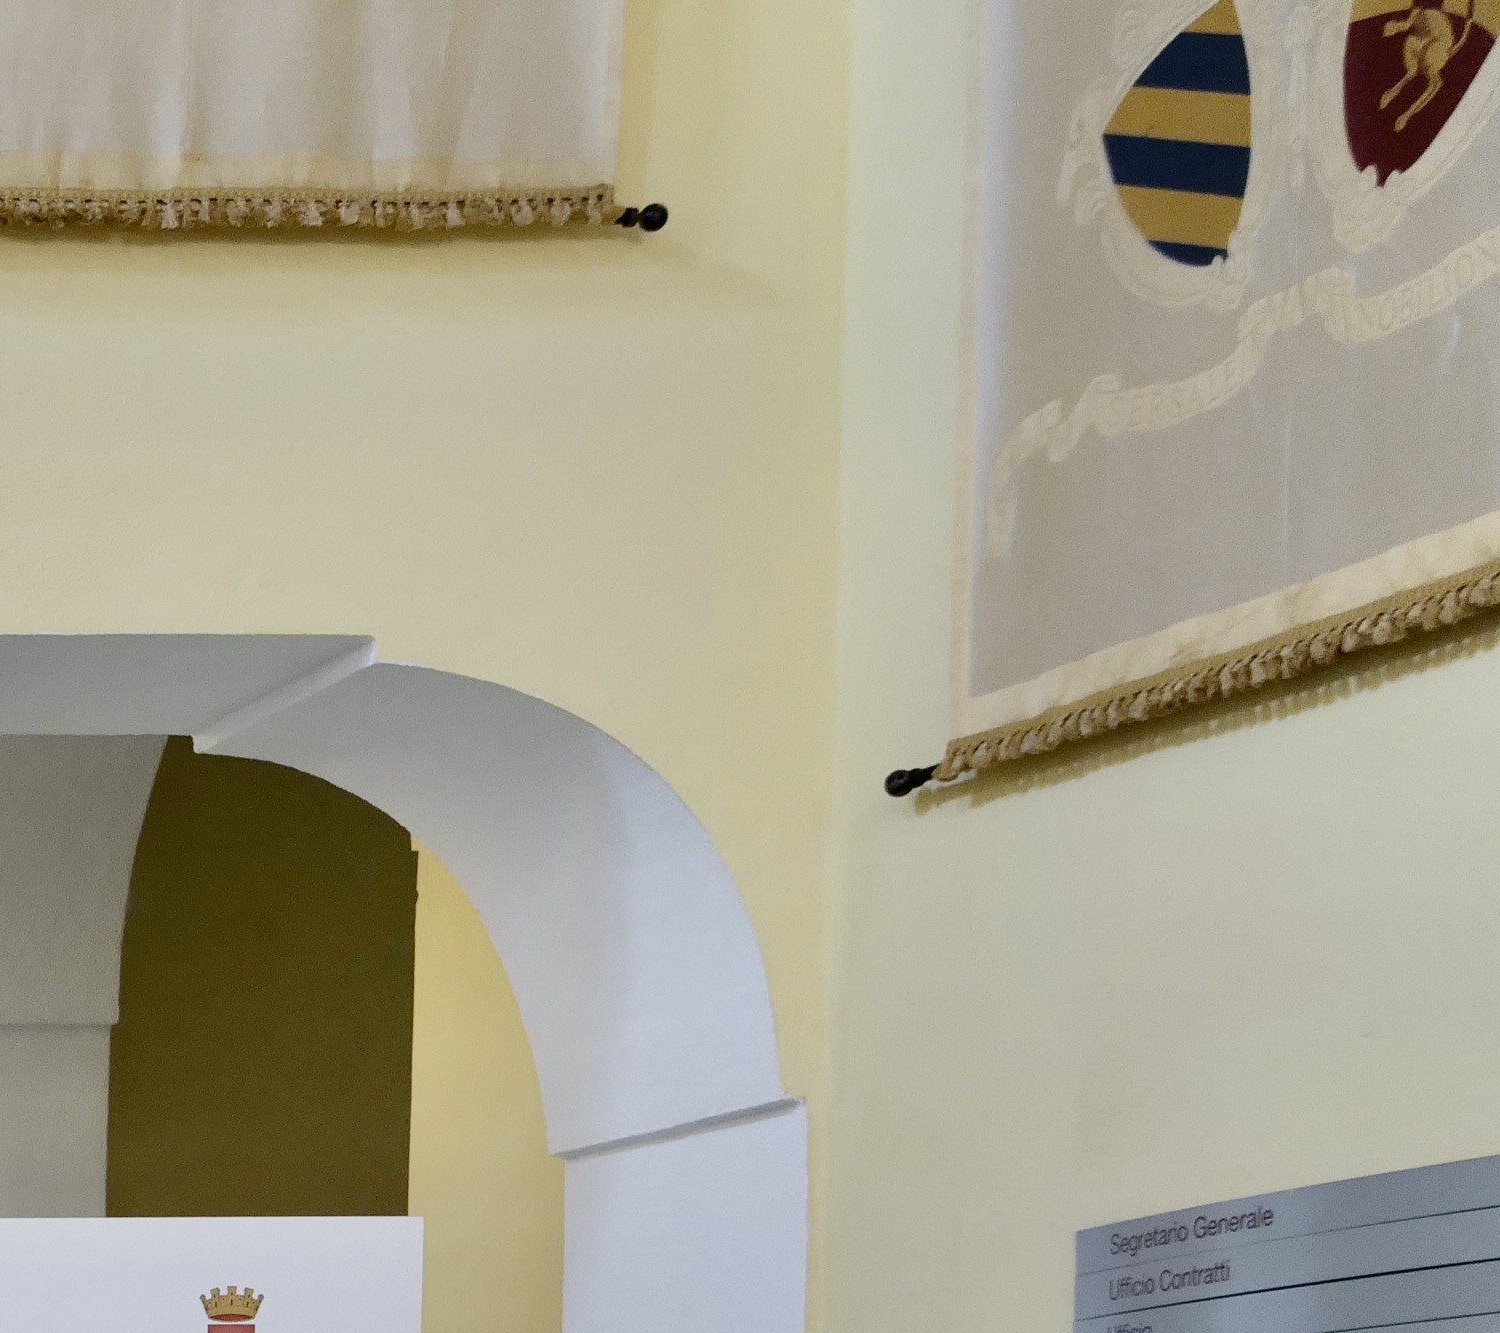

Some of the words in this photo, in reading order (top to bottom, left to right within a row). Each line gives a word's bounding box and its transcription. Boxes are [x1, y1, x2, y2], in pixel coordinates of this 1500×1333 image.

[1110, 1222, 1189, 1257] Segretario
[1193, 1206, 1274, 1240] Generale
[1108, 1271, 1155, 1301] Ufficio
[1159, 1260, 1231, 1292] Contratti
